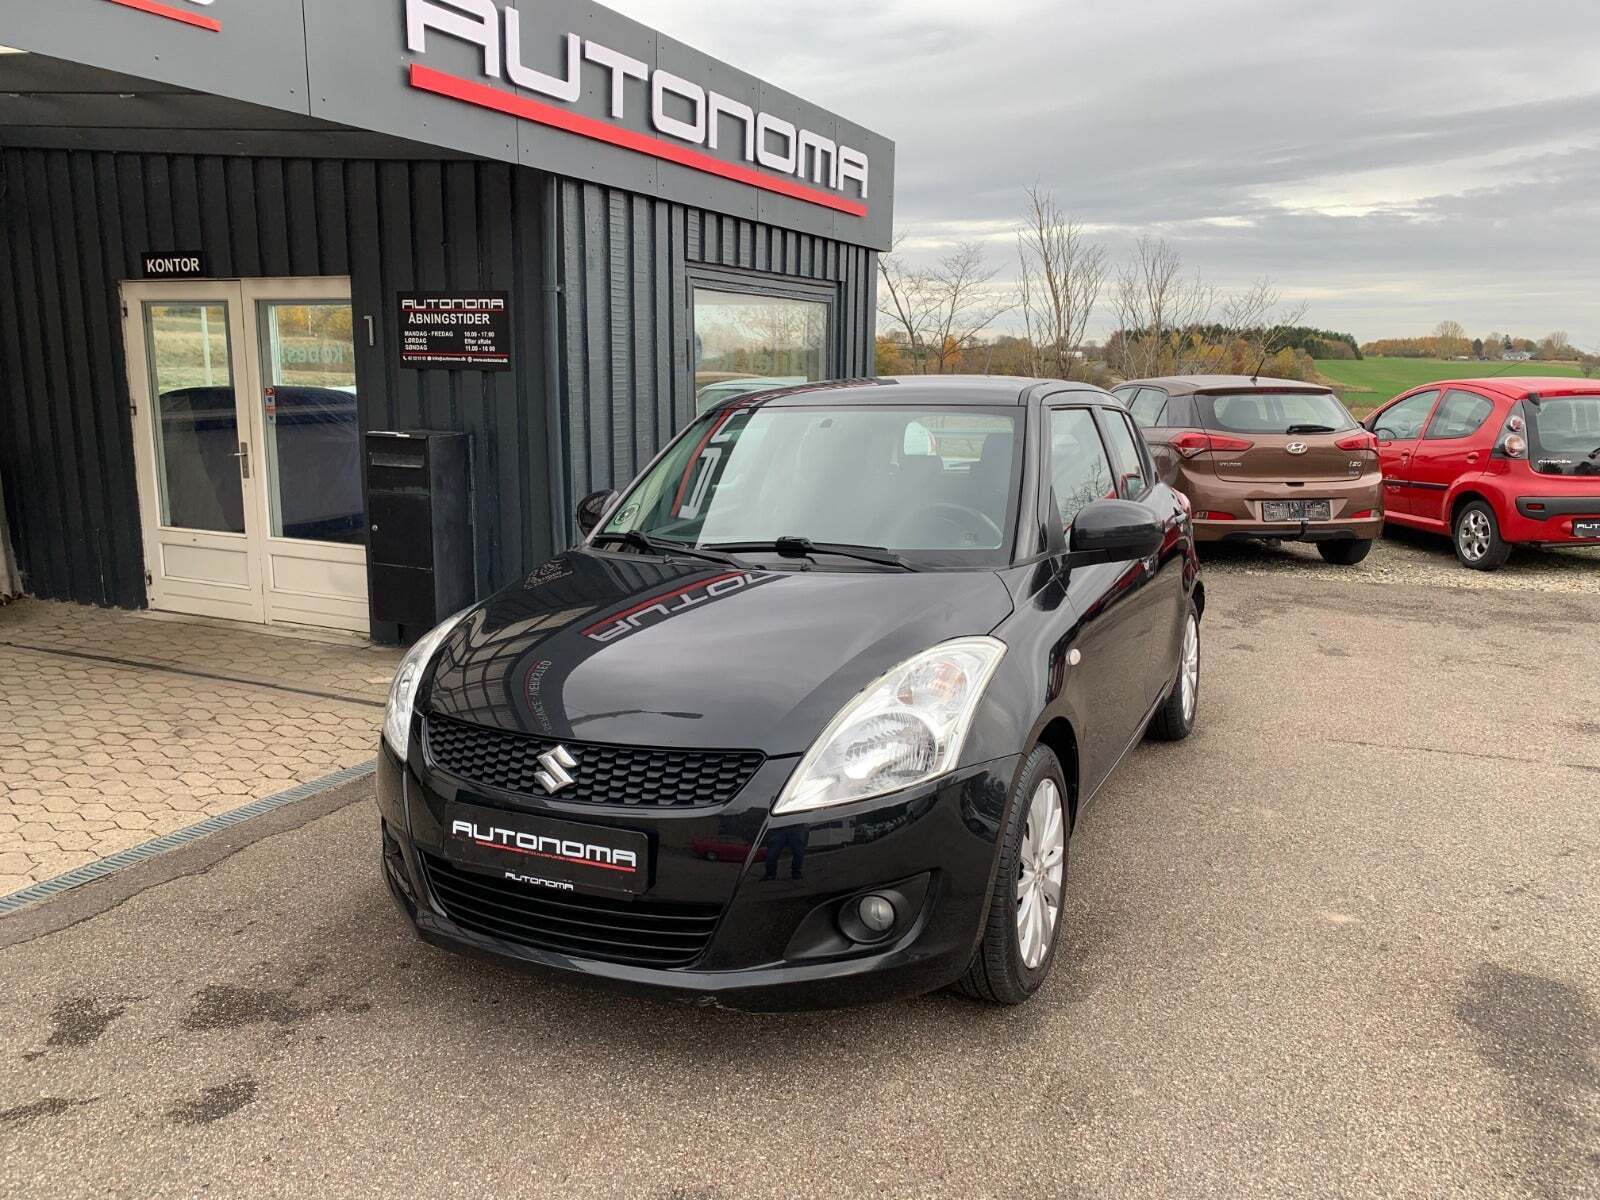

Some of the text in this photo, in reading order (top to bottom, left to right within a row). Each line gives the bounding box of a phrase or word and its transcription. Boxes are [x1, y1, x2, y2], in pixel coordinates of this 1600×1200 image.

[408, 0, 869, 199] AUTONOMA
[147, 257, 200, 273] KONTOR
[402, 299, 504, 309] AUTONOMA
[408, 312, 490, 324] ÅBNINGSTIDER
[452, 819, 637, 867] AUTONOMA
[505, 871, 574, 891] AUTONOMA
